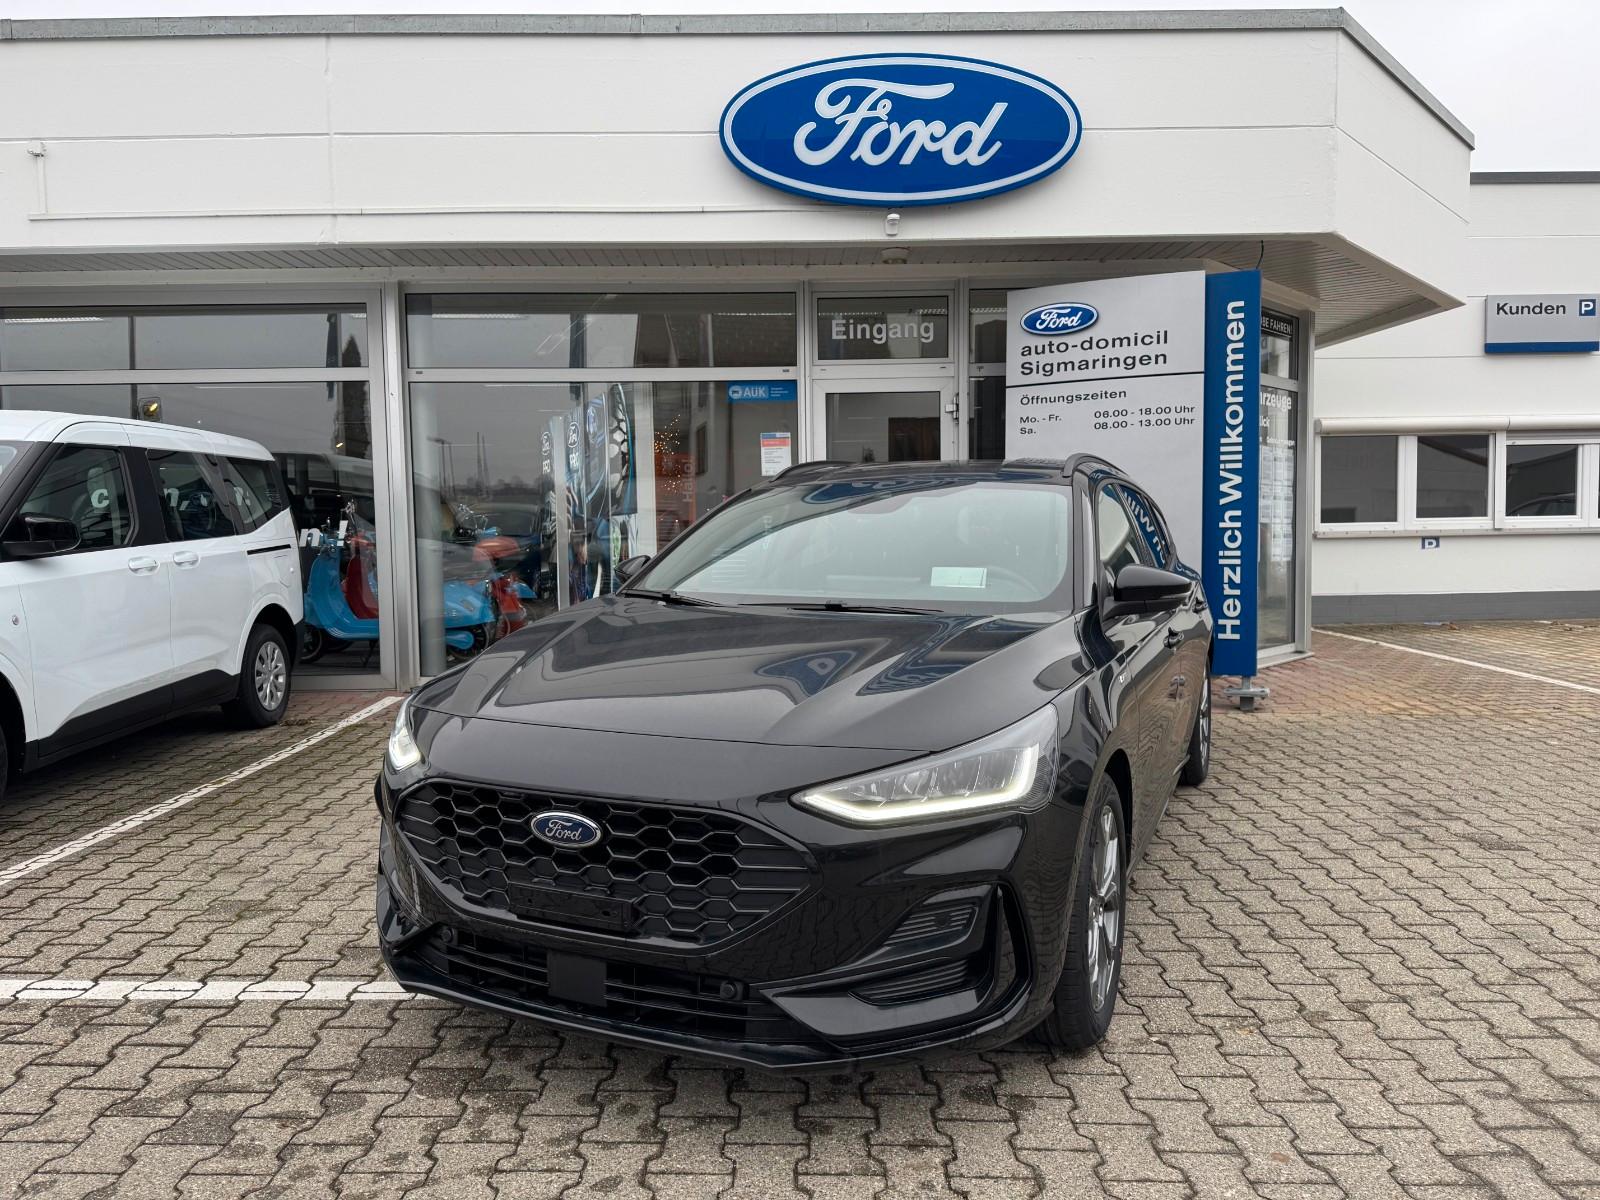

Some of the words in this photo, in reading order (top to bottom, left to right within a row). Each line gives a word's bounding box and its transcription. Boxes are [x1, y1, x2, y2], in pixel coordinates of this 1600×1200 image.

[793, 78, 1009, 167] Ford
[1035, 308, 1083, 331] Ford
[1496, 302, 1567, 316] Kunden
[1581, 301, 1594, 315] P
[831, 319, 934, 345] Eingang
[1020, 330, 1168, 357] auto-domicil
[1020, 353, 1168, 377] Sigmaringen
[1019, 390, 1127, 406] Öffnungszeiten
[1219, 300, 1245, 505] Willkommen
[1019, 416, 1040, 424] Mo.
[1048, 414, 1062, 422] Fr.
[1138, 406, 1172, 416] 18.00
[1174, 405, 1196, 414] Uhr
[1019, 427, 1037, 435] Sa.
[1093, 420, 1128, 430] 08.00
[1138, 418, 1172, 428] 13.00
[1174, 417, 1196, 426] Uhr
[1217, 509, 1242, 640] Herzlich
[545, 819, 583, 841] Ford
